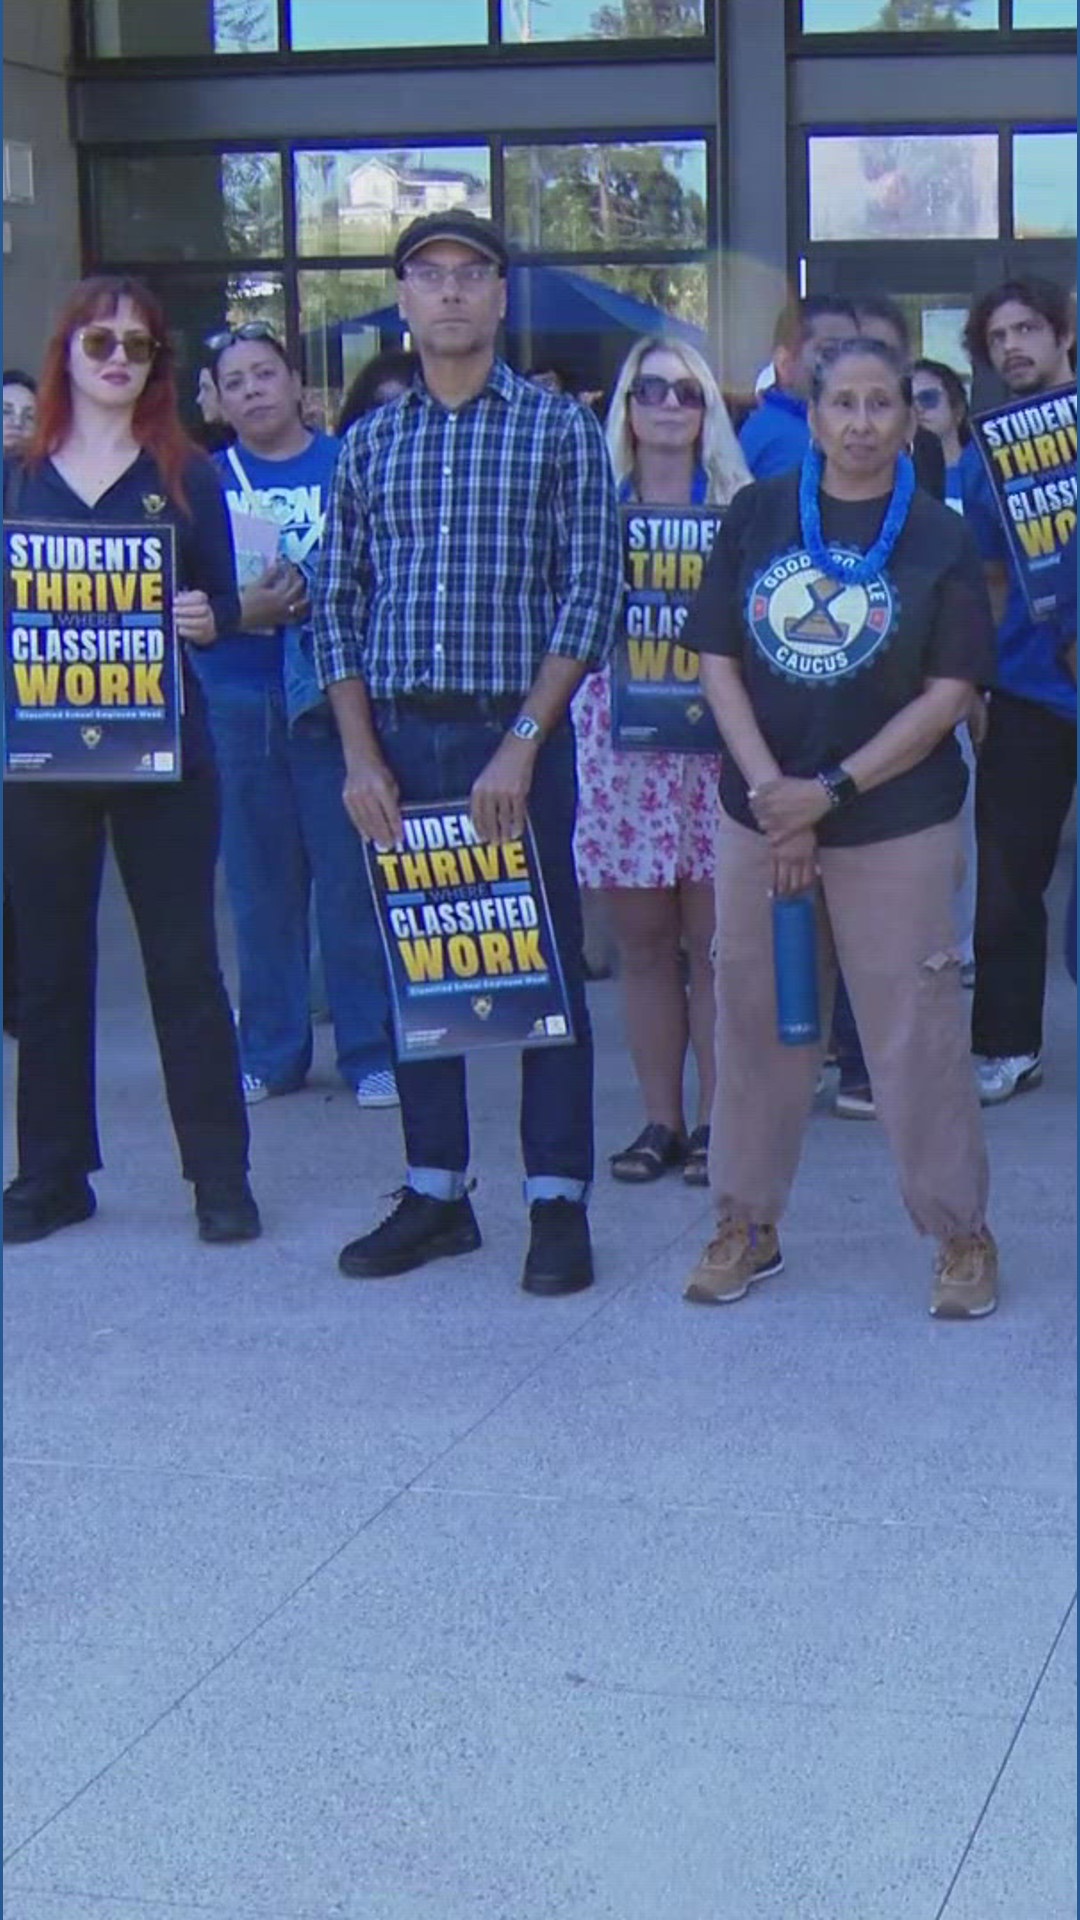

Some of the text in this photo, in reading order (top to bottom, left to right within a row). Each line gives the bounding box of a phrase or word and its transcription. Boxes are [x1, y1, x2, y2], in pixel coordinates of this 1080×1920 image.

[10, 533, 163, 571] STUDENTS
[628, 517, 721, 551] STUDE
[628, 551, 705, 590] THR
[763, 555, 812, 589] GOOD
[11, 571, 163, 612] THRIVE
[57, 613, 120, 627] WHERE
[11, 628, 165, 663] CLASSIFIED
[775, 646, 849, 674] CAUCUS
[13, 663, 165, 707] WORK
[377, 841, 529, 892] THRIVE
[429, 883, 489, 902] WHERE
[389, 895, 539, 939] CLASSIFIED
[398, 929, 548, 983] WORK
